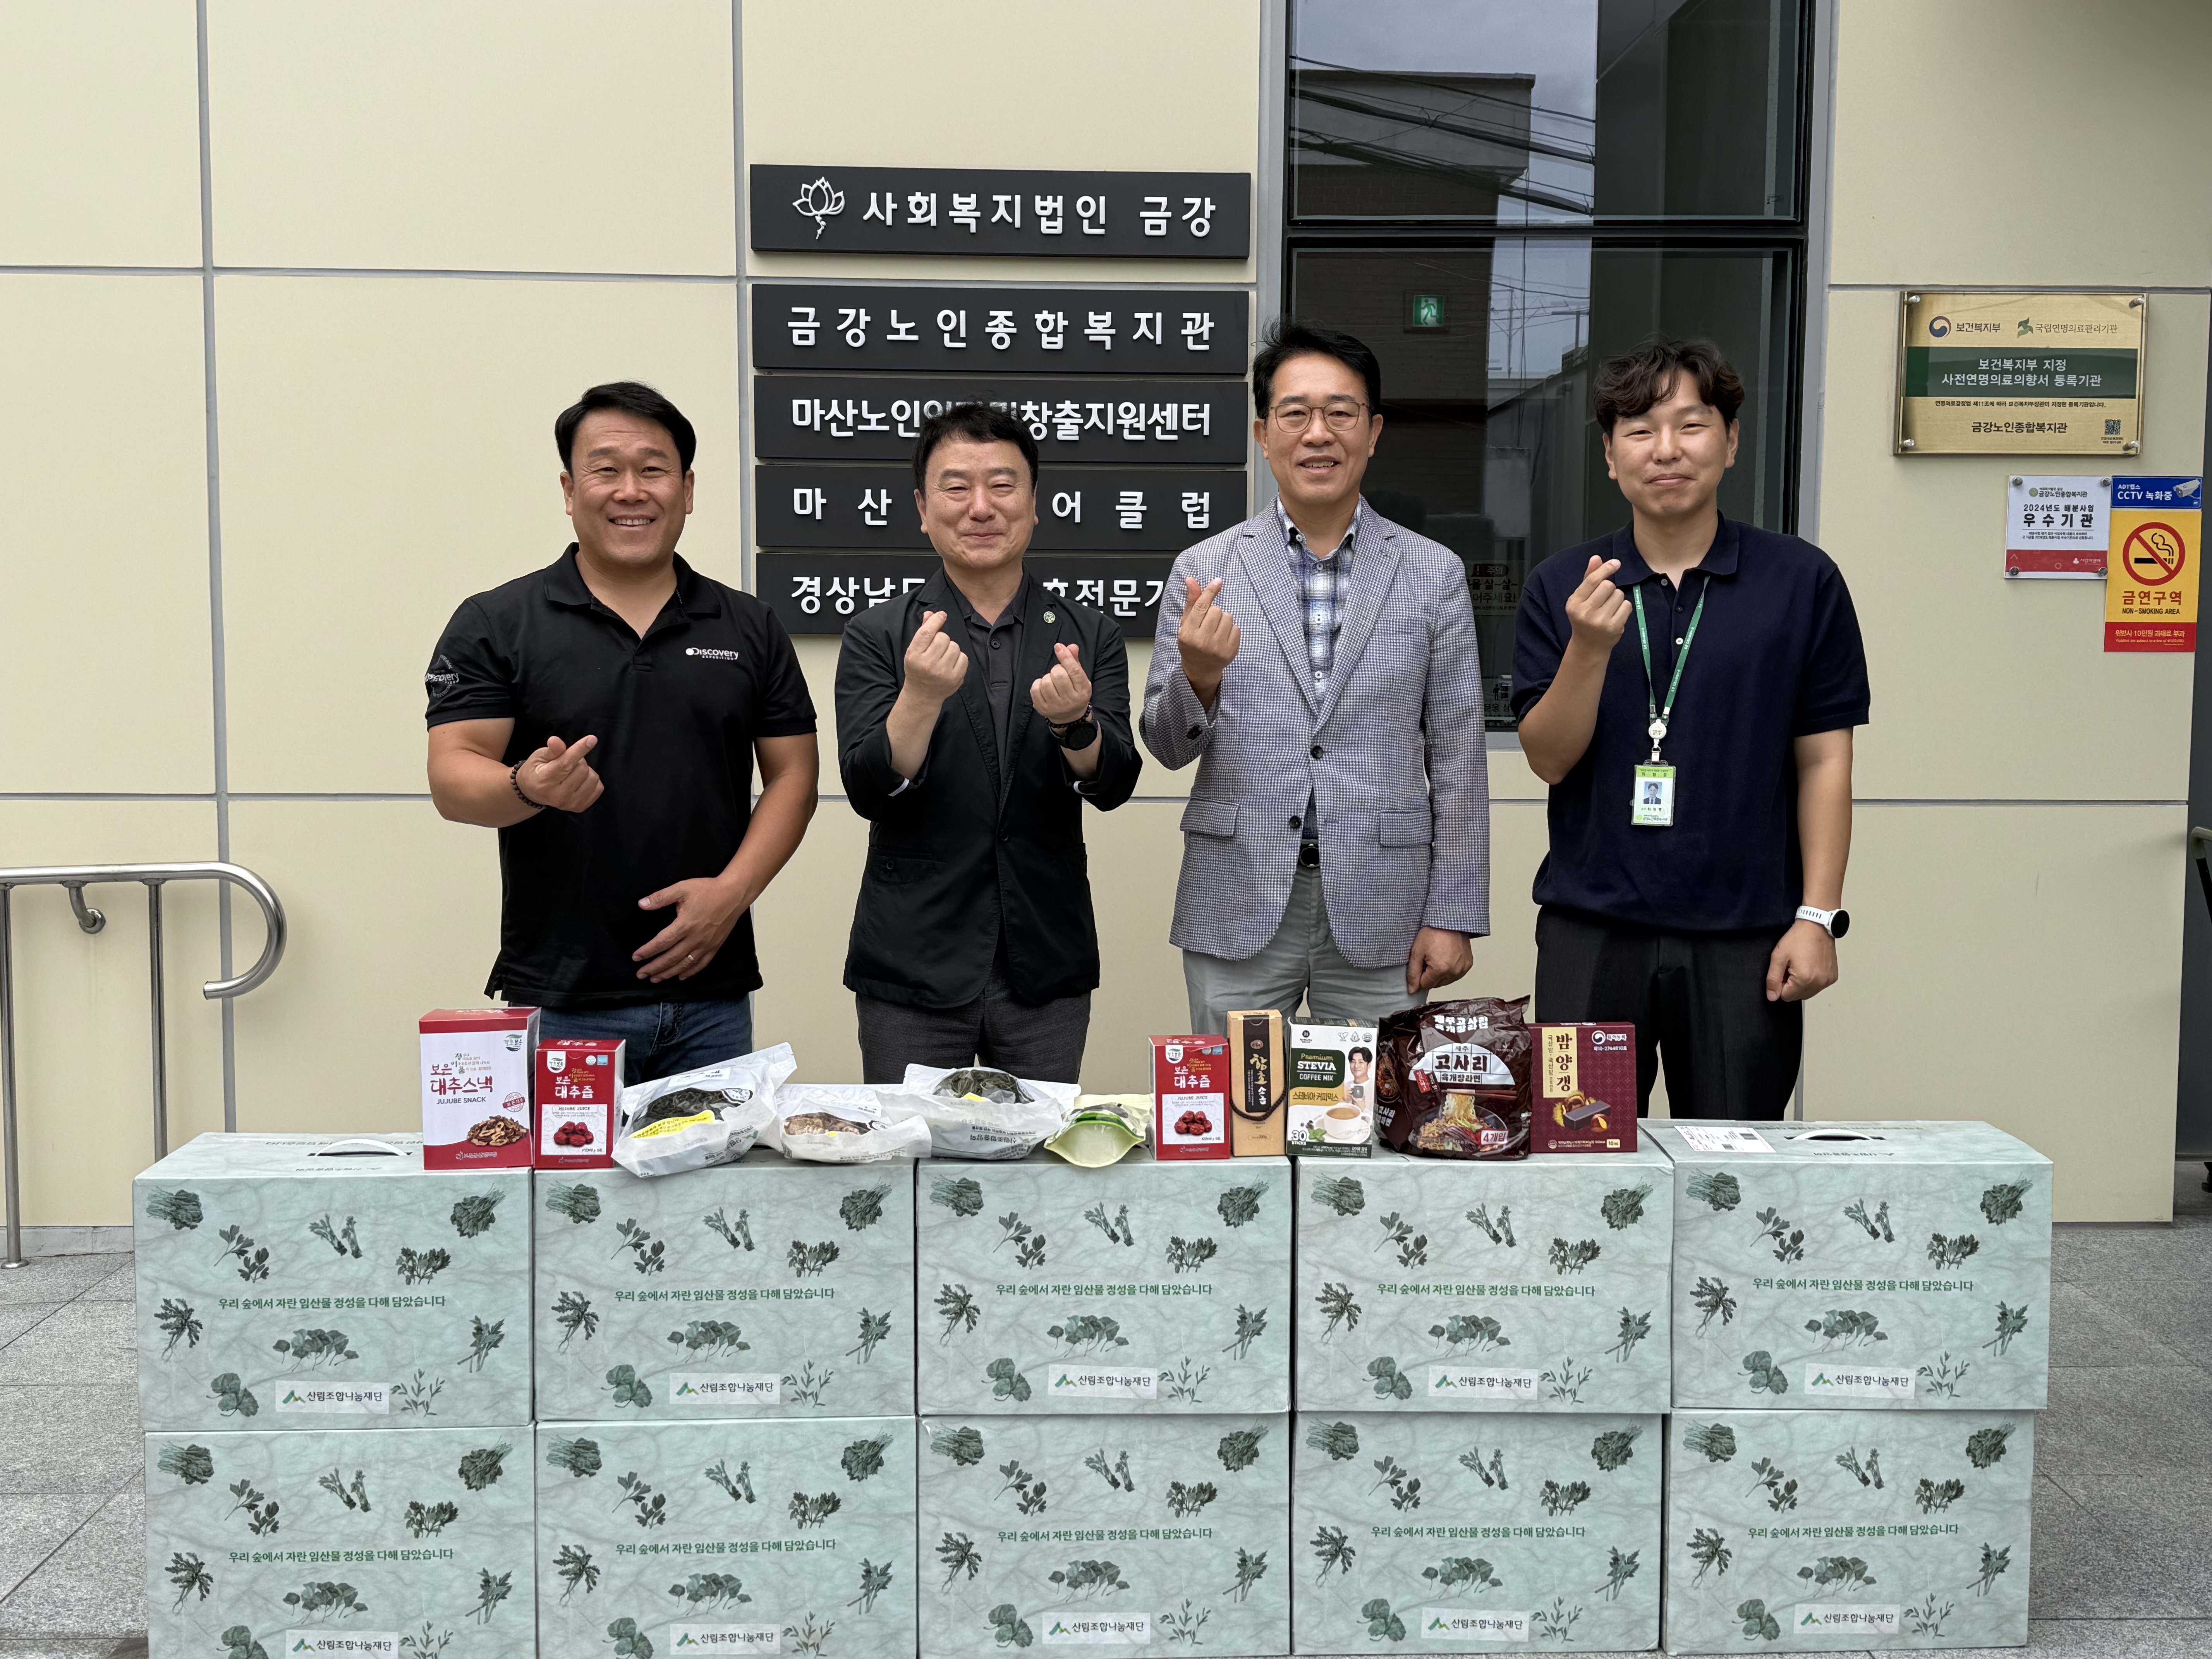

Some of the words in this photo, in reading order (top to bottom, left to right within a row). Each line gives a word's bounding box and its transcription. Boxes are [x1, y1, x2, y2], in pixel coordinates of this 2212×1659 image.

[863, 191, 1106, 235] 사회복지법인
[1139, 196, 1216, 237] 금강
[788, 306, 1214, 351] 금강노인종합복지관
[1956, 323, 2001, 333] 보건복지부
[2035, 323, 2118, 334] 국립연명의료관리기관
[1978, 359, 2038, 371] 보건복지부
[2043, 359, 2067, 371] 지정
[1942, 373, 2049, 386] 사전연명의료의향서
[2054, 374, 2102, 387] 등록기관
[792, 399, 1210, 441] 마산노인창출지원센터
[1971, 421, 2068, 433] 금강노인종합복지관
[2118, 491, 2142, 500] CCTV
[2145, 491, 2172, 501] 녹화중
[2023, 514, 2094, 528] 우수기관
[2122, 591, 2182, 606] 금연구역
[686, 647, 738, 660] Discovery
[1297, 1061, 1336, 1071] STEVIA
[1435, 1054, 1487, 1072] 고사리
[1556, 1033, 1573, 1091] 밤양갱
[430, 1063, 452, 1075] 보은
[1174, 1066, 1188, 1075] 보은
[555, 1076, 571, 1084] 보은
[1174, 1075, 1211, 1089] 대추즙
[1441, 1073, 1481, 1083] 육개장라면
[430, 1075, 493, 1095] 대추스낵
[555, 1085, 594, 1098] 대추즙
[1258, 1086, 1266, 1105] 소금
[1293, 1091, 1315, 1101] 스테비아
[1316, 1092, 1339, 1101] 커피믹스
[1291, 1130, 1307, 1141] 30
[1483, 1132, 1506, 1142] 4개입
[996, 1284, 1015, 1295] 우리
[1018, 1284, 1048, 1295] 숲에서
[1051, 1284, 1072, 1295] 자란
[1073, 1284, 1104, 1295] 임산물
[1106, 1284, 1137, 1296] 정성을
[1139, 1284, 1159, 1295] 다해
[1161, 1284, 1212, 1295] 담았습니다
[1377, 1283, 1397, 1295] 우리
[1399, 1284, 1430, 1295] 숲에서
[1432, 1284, 1453, 1295] 자란
[1455, 1285, 1486, 1295] 임산물
[1488, 1285, 1519, 1296] 정성을
[1521, 1285, 1541, 1296] 다해
[1544, 1285, 1595, 1297] 담았습니다
[1753, 1278, 1773, 1289] 우리
[1775, 1278, 1807, 1290] 숲에서
[1809, 1279, 1830, 1290] 자란
[1832, 1279, 1863, 1291] 임산물
[1865, 1280, 1897, 1291] 정성을
[1899, 1280, 1919, 1291] 다해
[1922, 1280, 1974, 1291] 담았습니다
[615, 1291, 634, 1302] 우리
[637, 1290, 668, 1302] 숲에서
[670, 1290, 692, 1301] 자란
[693, 1290, 725, 1301] 임산물
[727, 1289, 758, 1300] 정성을
[760, 1288, 780, 1300] 다해
[783, 1288, 835, 1300] 담았습니다
[218, 1298, 239, 1310] 우리
[241, 1298, 273, 1309] 숲에서
[275, 1298, 297, 1309] 자란
[299, 1297, 332, 1309] 임산물
[334, 1297, 366, 1309] 정성을
[368, 1297, 390, 1308] 다해
[392, 1295, 447, 1307] 담았습니다
[1078, 1375, 1151, 1387] 산림조합나눔재단
[1459, 1376, 1532, 1388] 산림조합나눔재단
[1835, 1374, 1909, 1387] 산림조합나눔재단
[700, 1382, 773, 1393] 산림조합나눔재단
[306, 1391, 382, 1402] 산림조합나눔재단
[997, 1531, 1017, 1542] 우리
[1019, 1531, 1049, 1542] 숲에서
[1052, 1530, 1073, 1541] 자란
[1074, 1530, 1105, 1541] 임산물
[1108, 1529, 1138, 1540] 정성을
[1140, 1529, 1159, 1540] 다해
[1162, 1528, 1213, 1539] 담았습니다
[1748, 1528, 1767, 1539] 우리
[1770, 1527, 1800, 1538] 숲에서
[1802, 1527, 1822, 1538] 자란
[1824, 1526, 1854, 1537] 임산물
[1856, 1526, 1886, 1537] 정성을
[1888, 1525, 1907, 1535] 다해
[1910, 1523, 1959, 1535] 담았습니다
[228, 1552, 249, 1563] 우리
[251, 1552, 283, 1563] 숲에서
[286, 1551, 307, 1562] 자란
[309, 1551, 341, 1562] 임산물
[343, 1550, 375, 1562] 정성을
[377, 1550, 398, 1561] 다해
[400, 1548, 454, 1561] 담았습니다
[1451, 1619, 1523, 1630] 산림조합나눔재단
[1824, 1613, 1894, 1625] 산림조합나눔재단
[1072, 1621, 1144, 1633] 산림조합나눔재단
[700, 1632, 774, 1644] 산림조합나눔재단
[316, 1640, 392, 1651] 산림조합나눔재단
